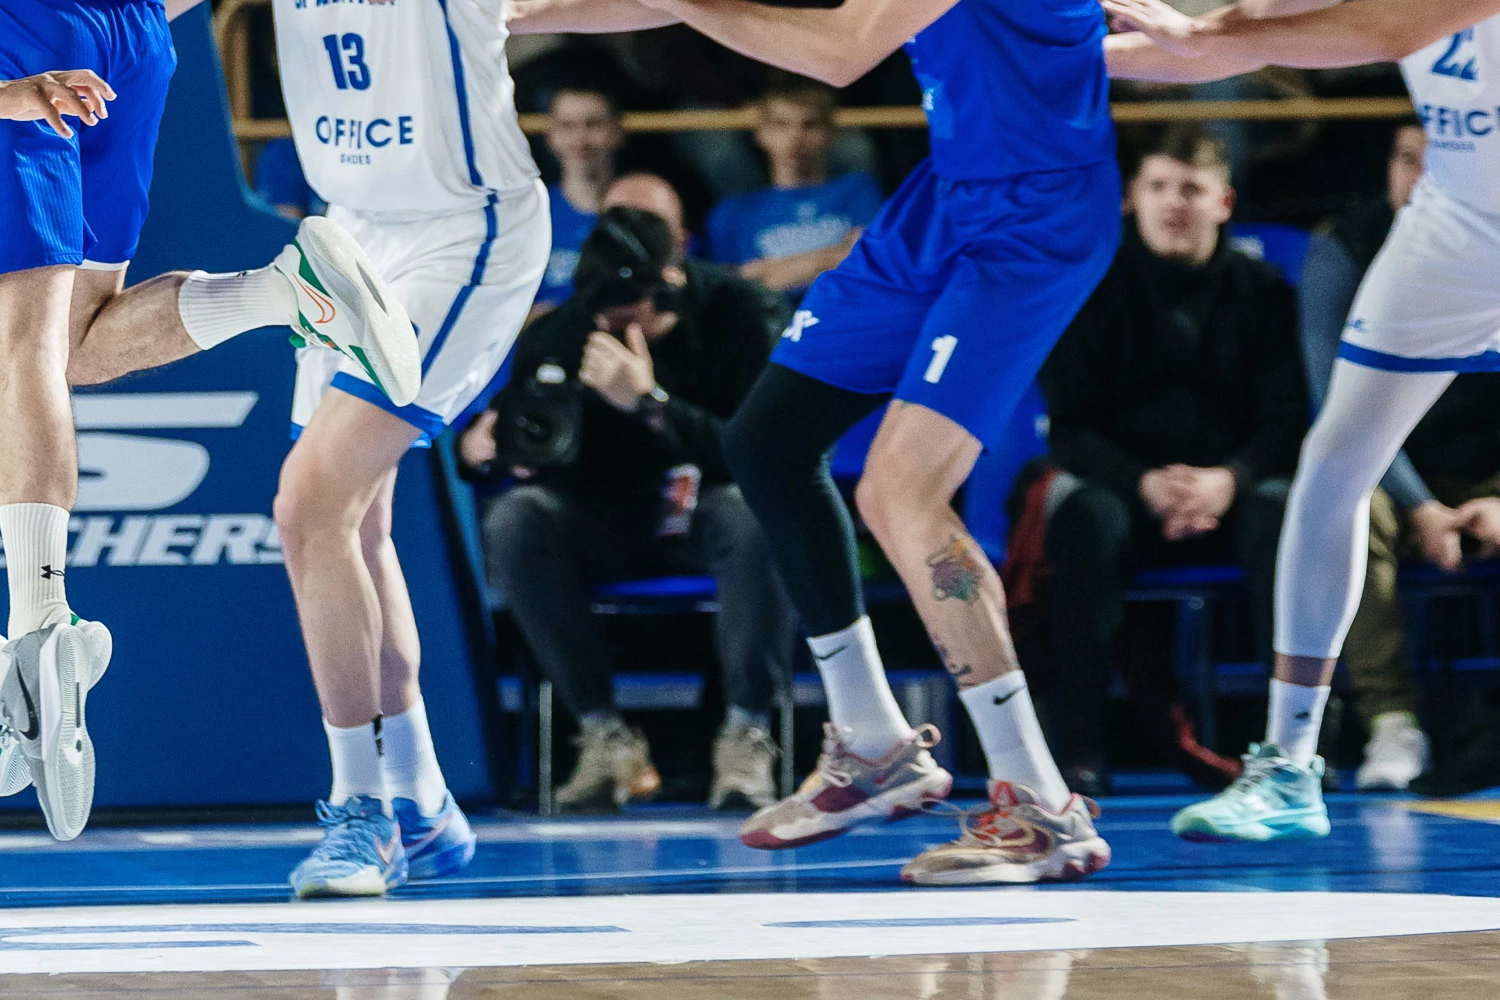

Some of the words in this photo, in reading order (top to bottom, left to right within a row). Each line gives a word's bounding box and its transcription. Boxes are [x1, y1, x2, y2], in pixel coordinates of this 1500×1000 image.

[323, 33, 372, 91] 13
[315, 115, 414, 149] OFFICE
[923, 334, 959, 385] 1
